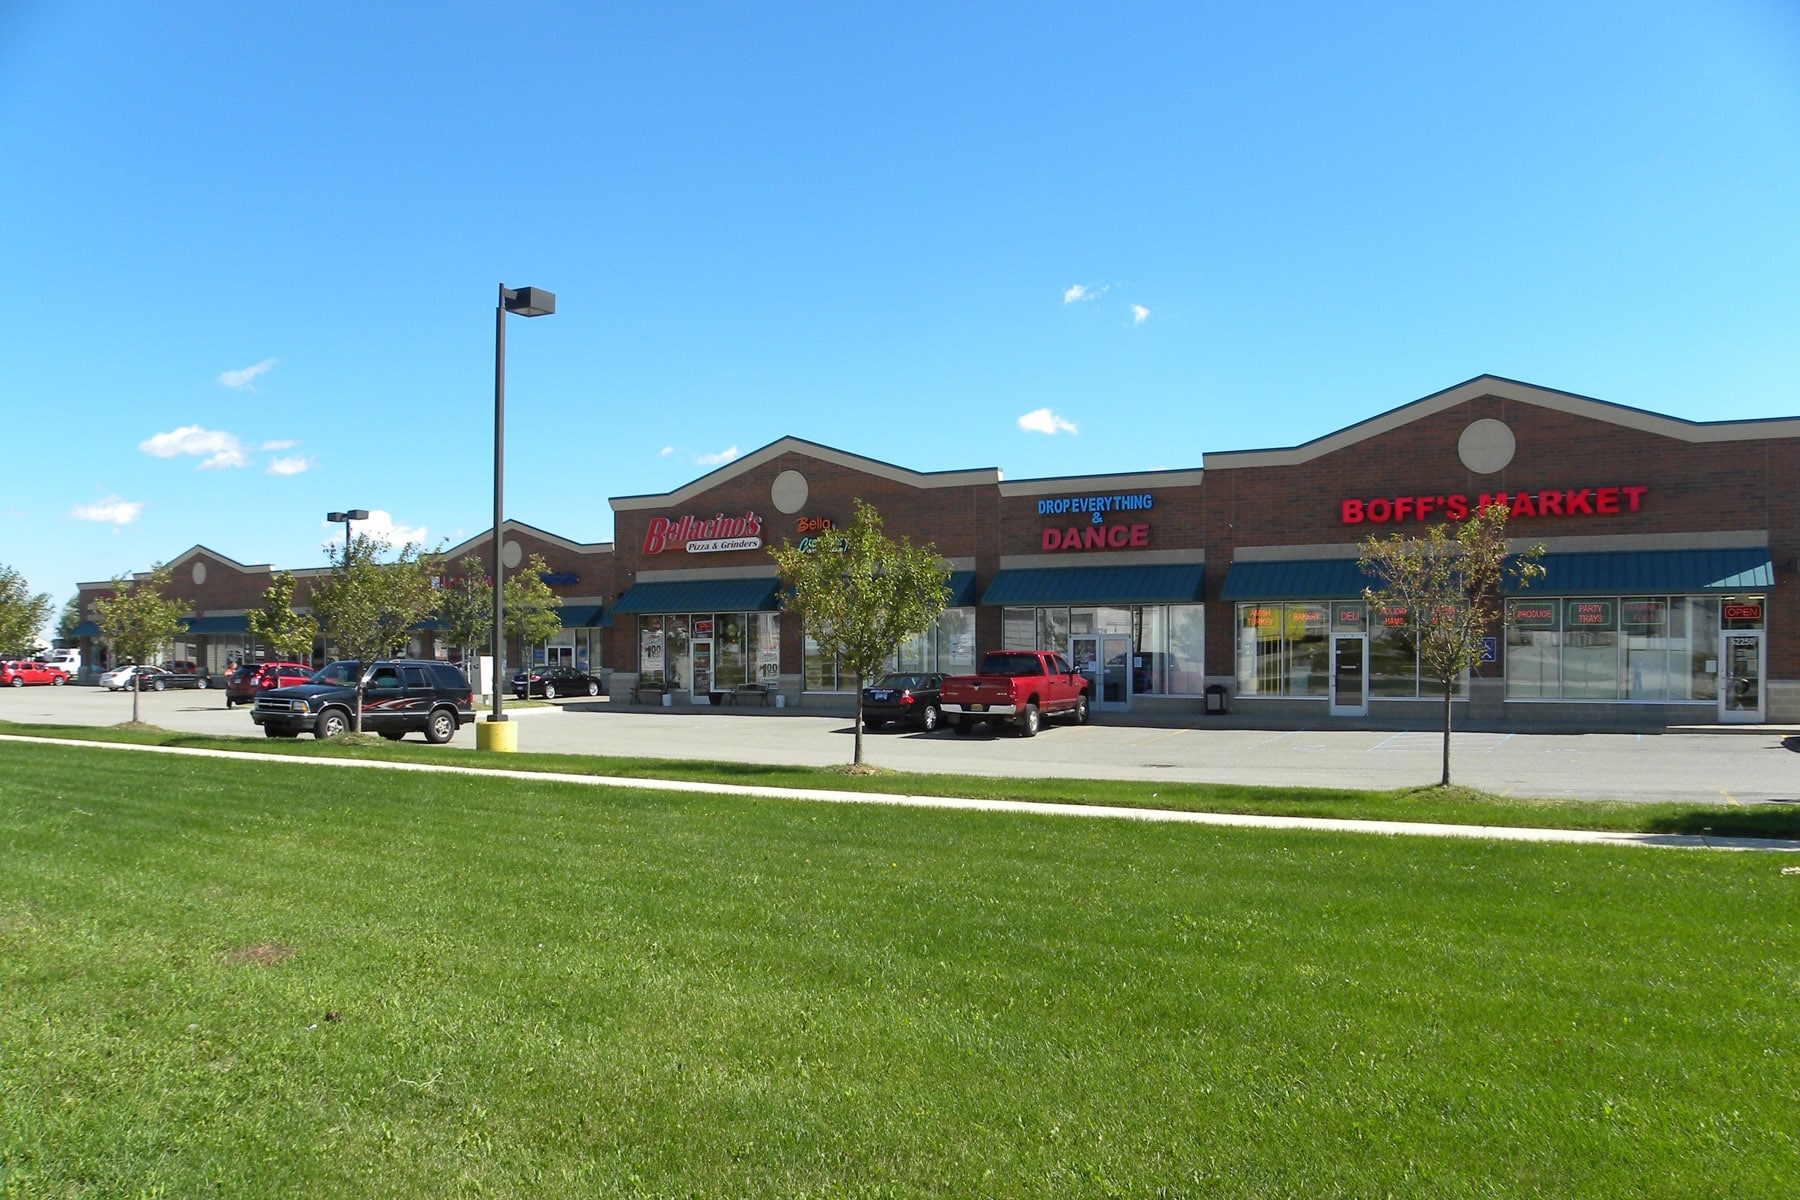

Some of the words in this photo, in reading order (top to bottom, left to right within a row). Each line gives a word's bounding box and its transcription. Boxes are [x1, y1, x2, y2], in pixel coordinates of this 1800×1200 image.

[1342, 492, 1468, 524] BOFF'S
[1479, 486, 1647, 519] MARKET
[1091, 511, 1104, 524] &
[796, 516, 831, 533] Bella
[642, 511, 762, 554] Bellacino's
[1041, 524, 1150, 550] DANCE
[688, 543, 710, 551] Pizza
[720, 540, 758, 549] Grinders
[1578, 604, 1602, 613] PARTY
[1727, 608, 1758, 617] OPEN
[1292, 612, 1321, 621] BAKERY
[1340, 611, 1360, 621] DELI
[1578, 615, 1603, 623] TRAYS
